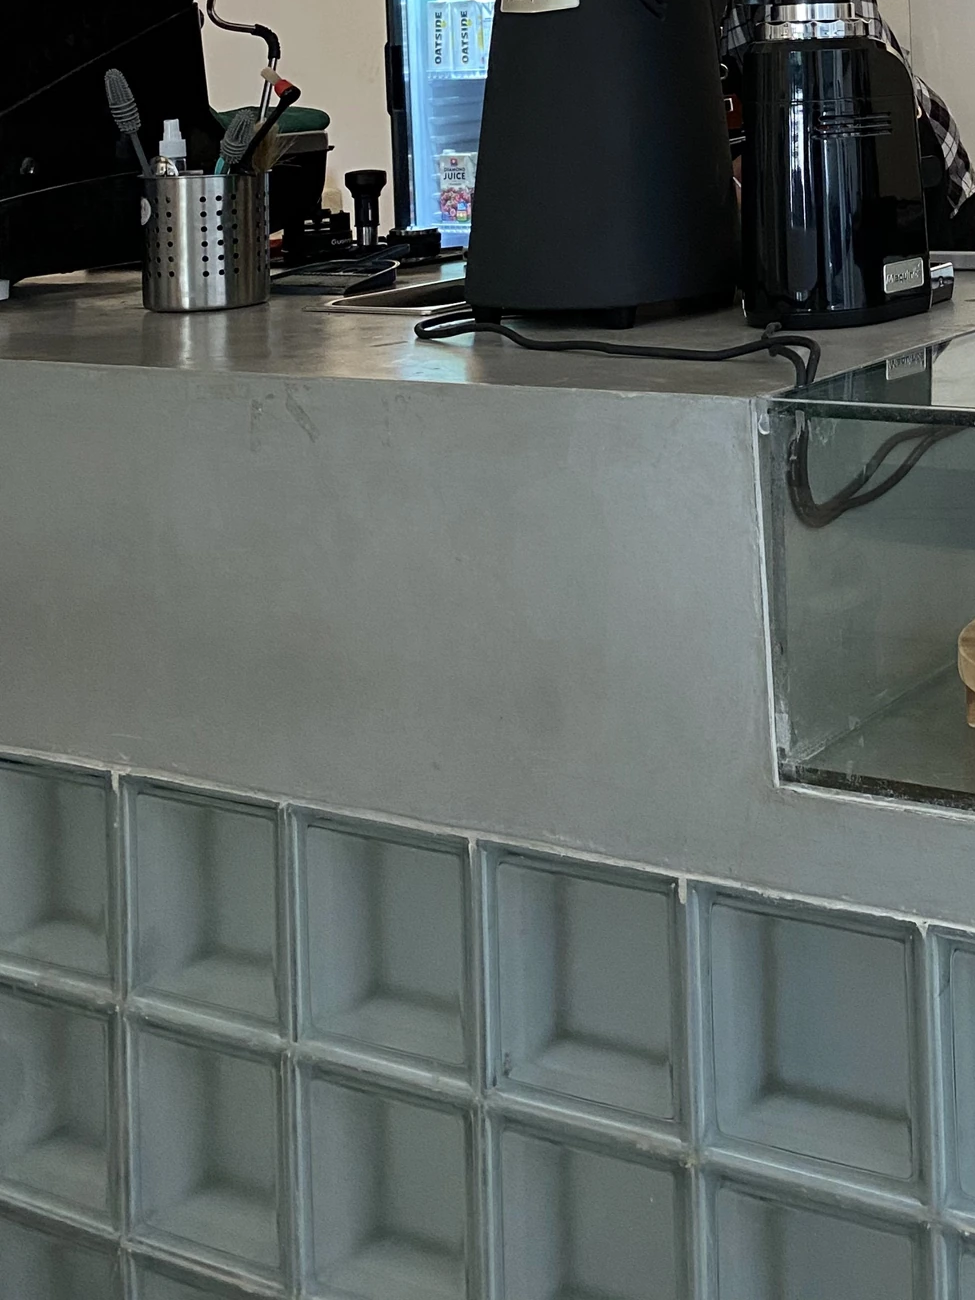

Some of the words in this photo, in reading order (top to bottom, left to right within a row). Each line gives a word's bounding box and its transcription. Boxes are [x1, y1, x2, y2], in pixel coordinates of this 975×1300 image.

[434, 11, 442, 65] OATSIDE
[461, 10, 469, 64] OATSIDE
[443, 172, 466, 180] JUICE
